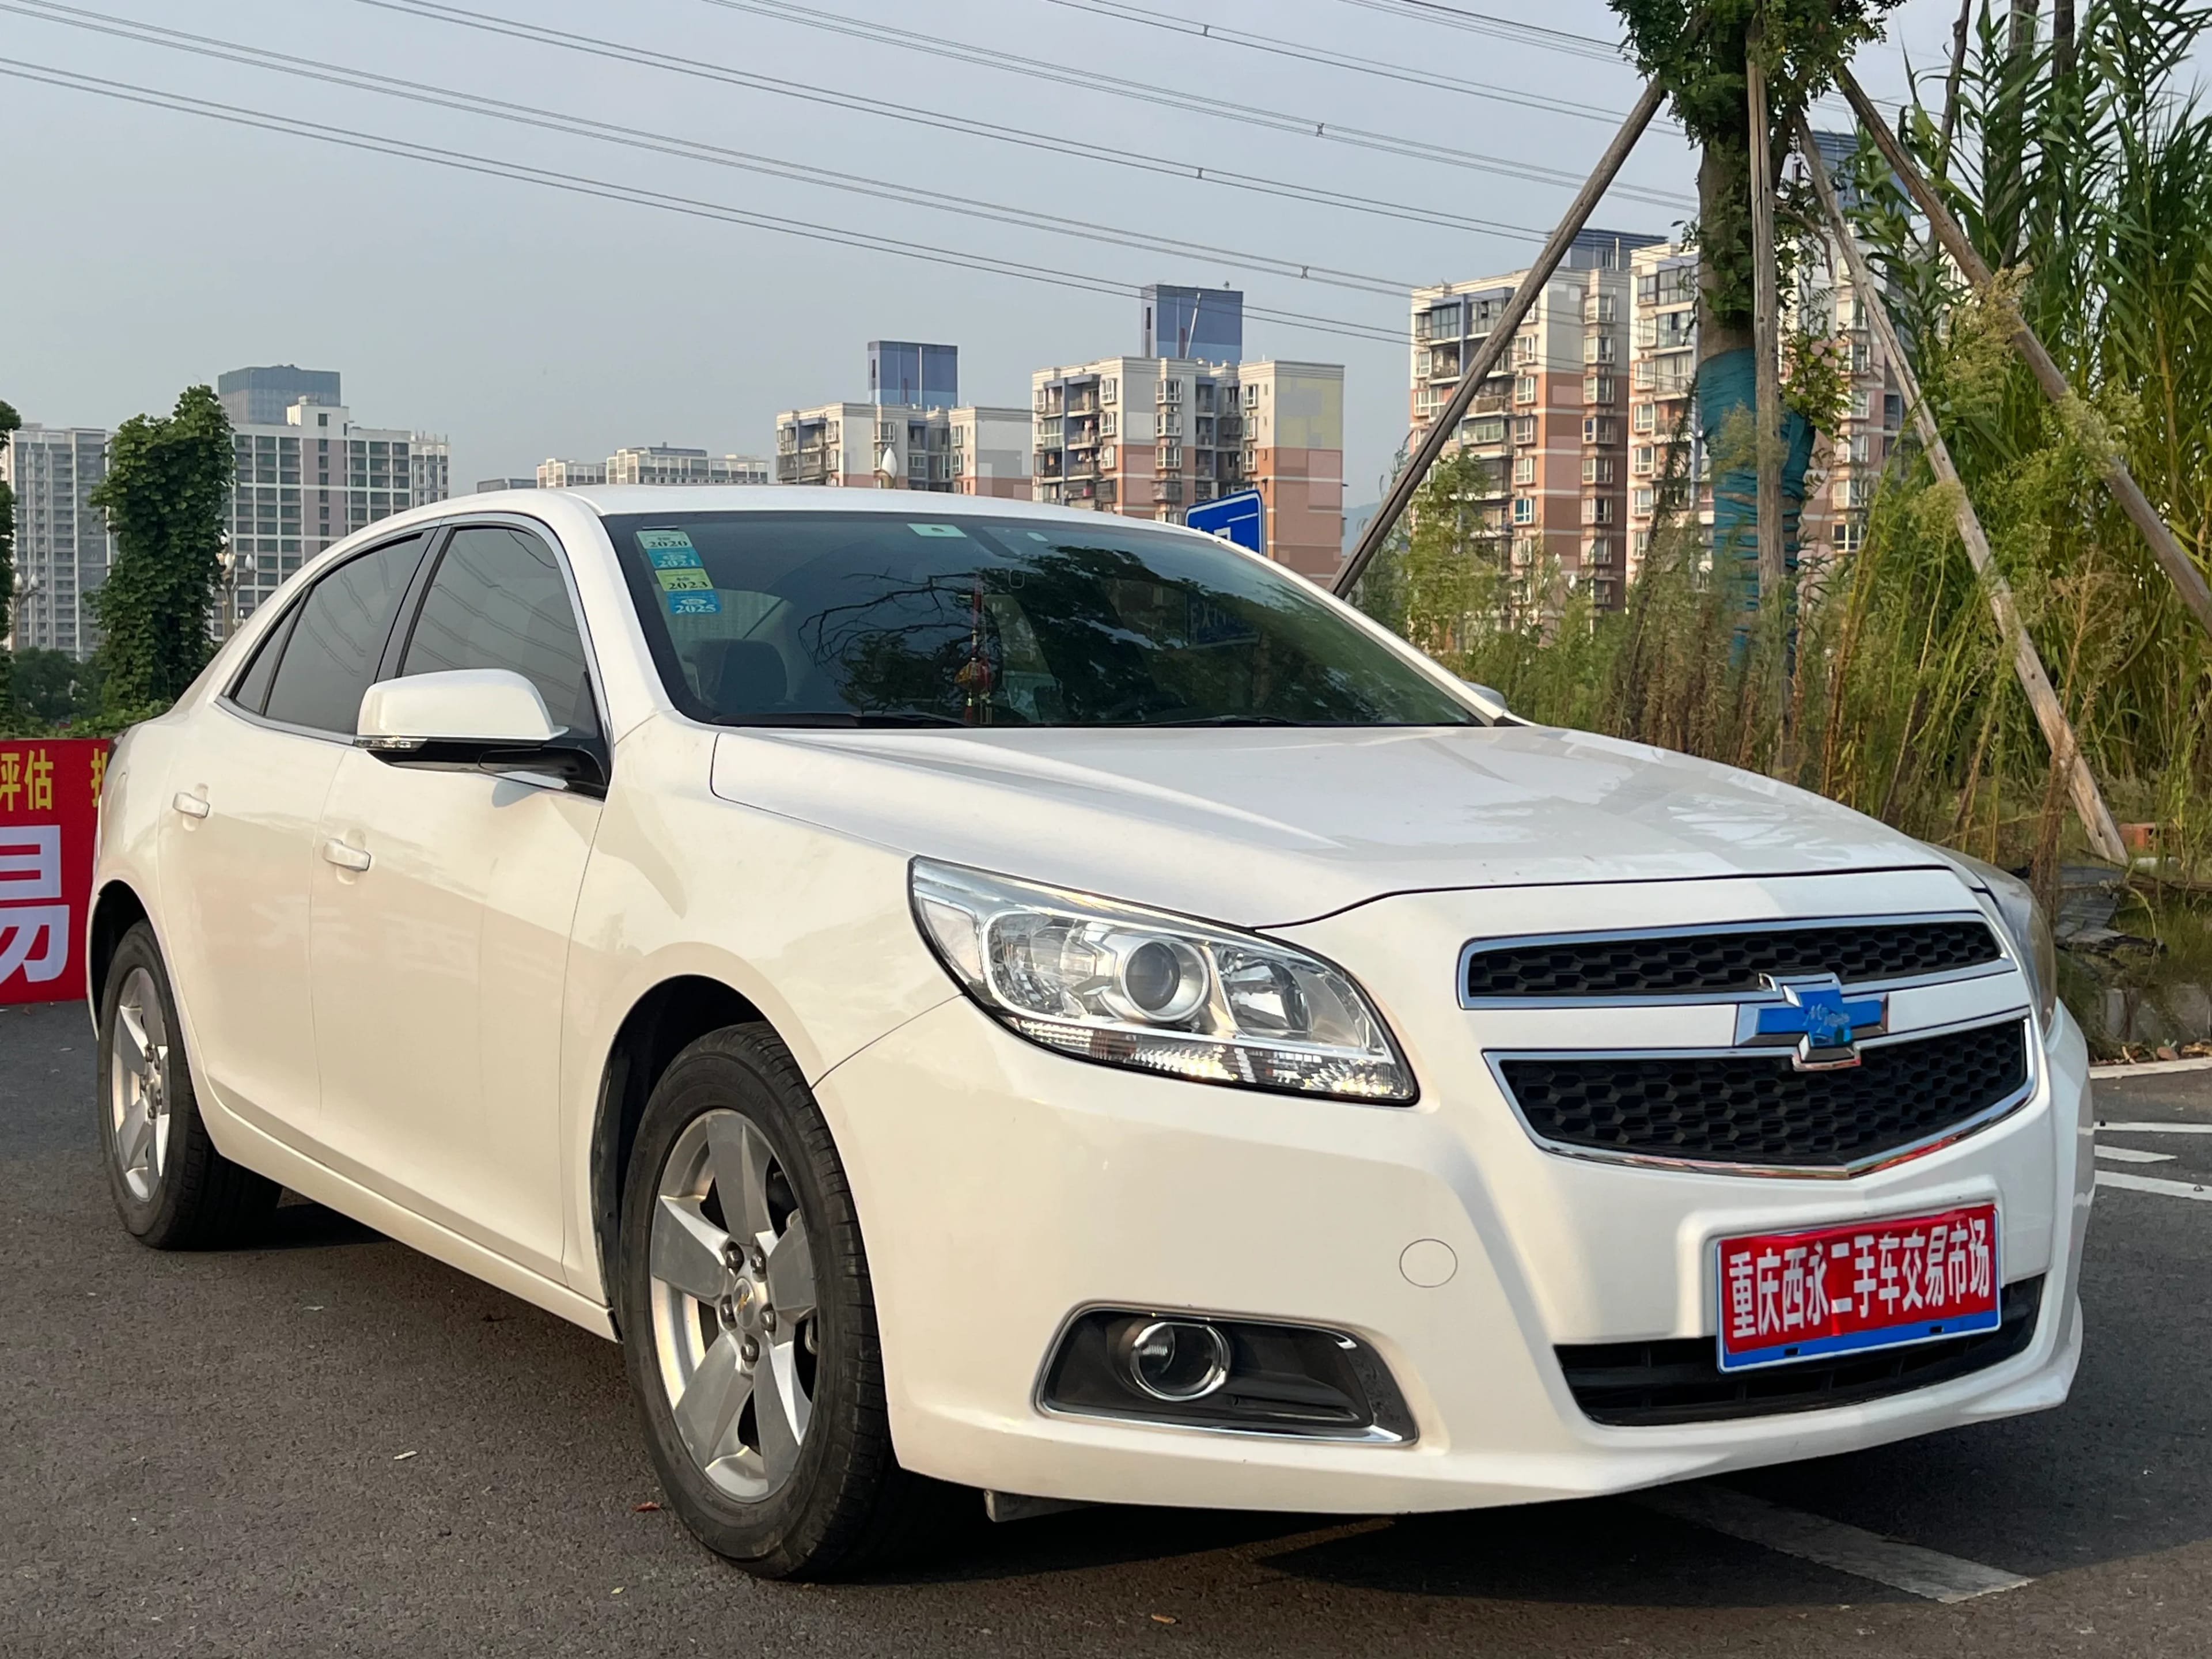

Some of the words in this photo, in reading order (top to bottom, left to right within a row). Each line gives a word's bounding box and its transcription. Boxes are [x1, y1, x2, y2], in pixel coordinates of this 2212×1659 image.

[668, 581, 708, 589] 2023
[675, 604, 716, 613] 2025
[0, 748, 54, 811] 评估
[1729, 1217, 1990, 1339] 重庆西永二手车交易市场
